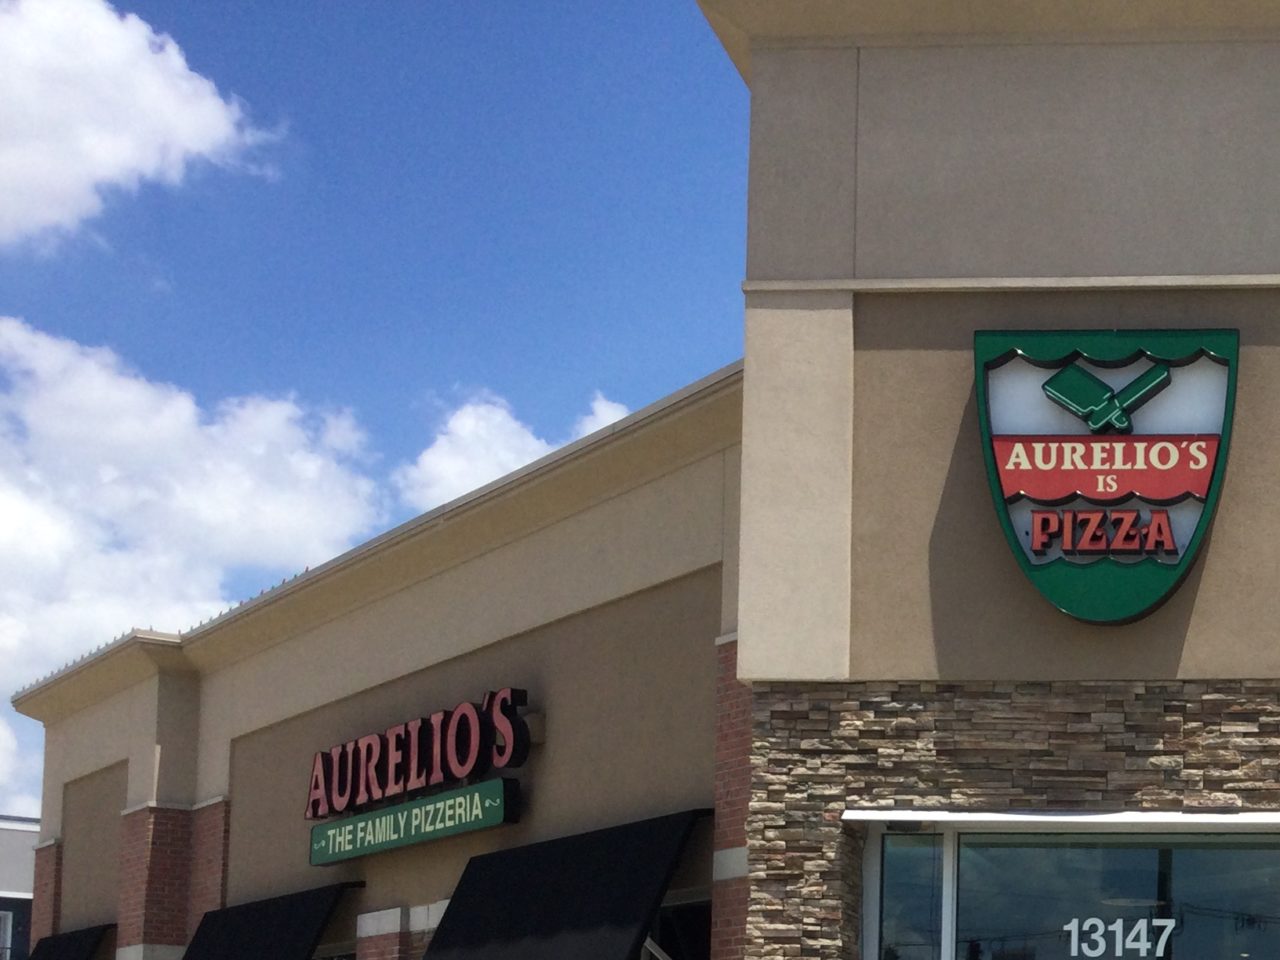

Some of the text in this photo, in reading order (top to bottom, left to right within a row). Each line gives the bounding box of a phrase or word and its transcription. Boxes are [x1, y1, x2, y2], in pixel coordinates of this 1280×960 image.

[1005, 441, 1208, 471] AURELIO'S
[1096, 475, 1118, 493] IS
[1030, 509, 1178, 556] PIZZA
[305, 687, 520, 820] AURELIO'S
[327, 792, 483, 855] THE FAMILY PIZZERIA
[1063, 917, 1176, 958] 13147
